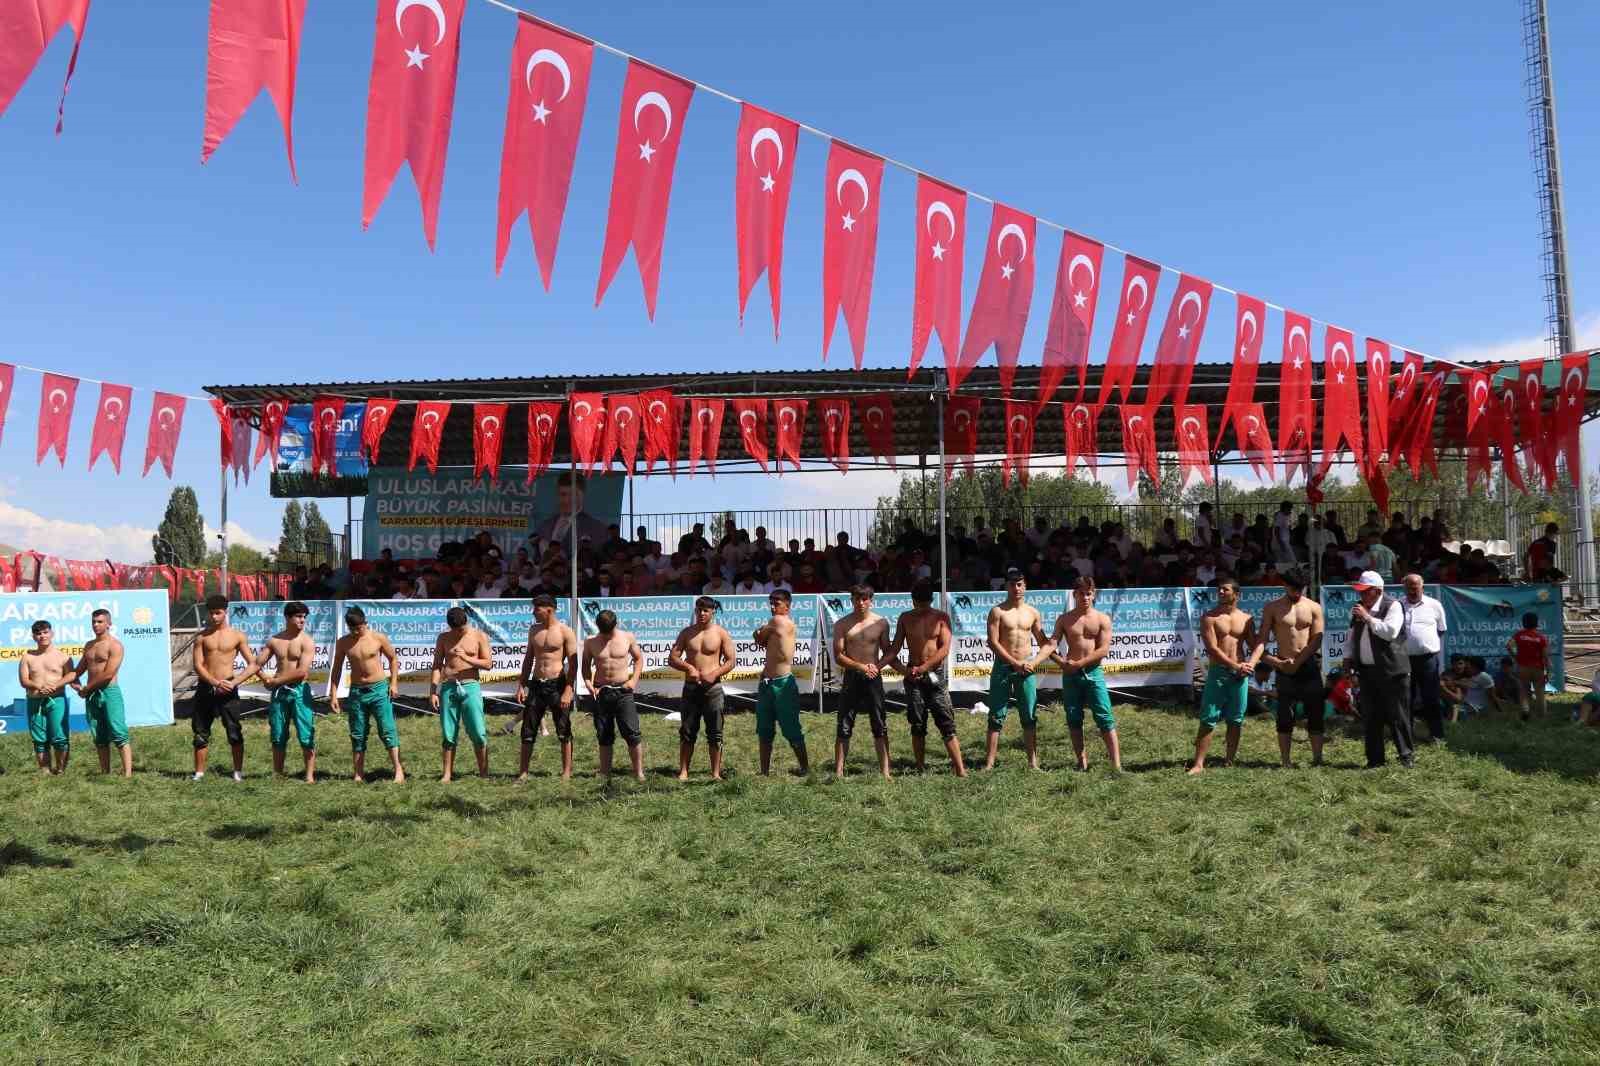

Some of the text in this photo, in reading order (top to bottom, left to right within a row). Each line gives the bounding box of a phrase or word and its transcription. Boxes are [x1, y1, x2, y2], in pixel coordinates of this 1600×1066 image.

[377, 478, 537, 496] ULUSLARARASI
[376, 497, 534, 515] BÜYÜK PASİNLER
[381, 517, 443, 526] KARAKUCAK
[1143, 646, 1187, 659] DİLERİM
